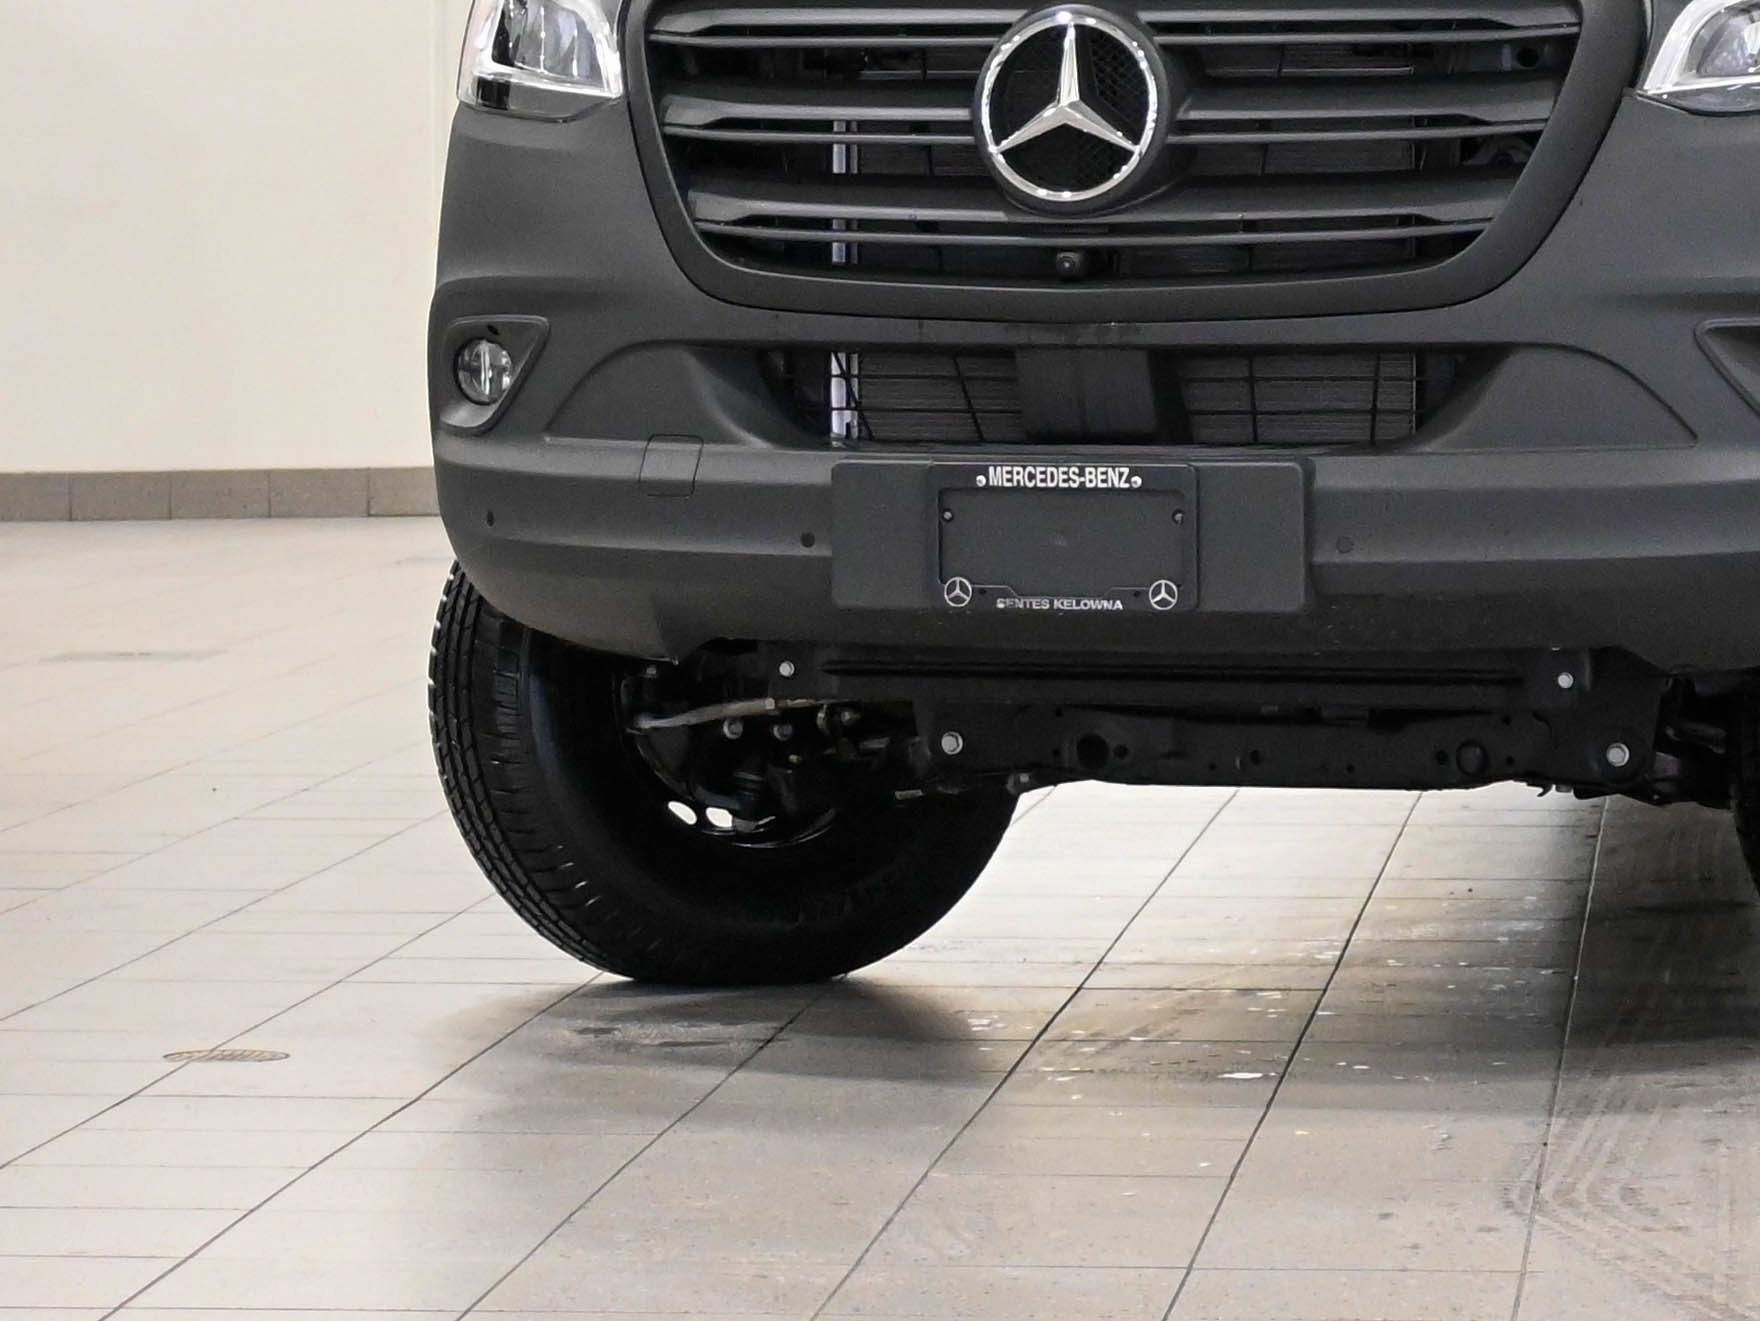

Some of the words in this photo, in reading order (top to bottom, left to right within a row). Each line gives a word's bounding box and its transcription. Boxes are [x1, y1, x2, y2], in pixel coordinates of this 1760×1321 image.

[988, 466, 1130, 488] MERCEDES-BENZ
[996, 598, 1050, 610] SENTES
[1053, 599, 1124, 610] KELOWNA
